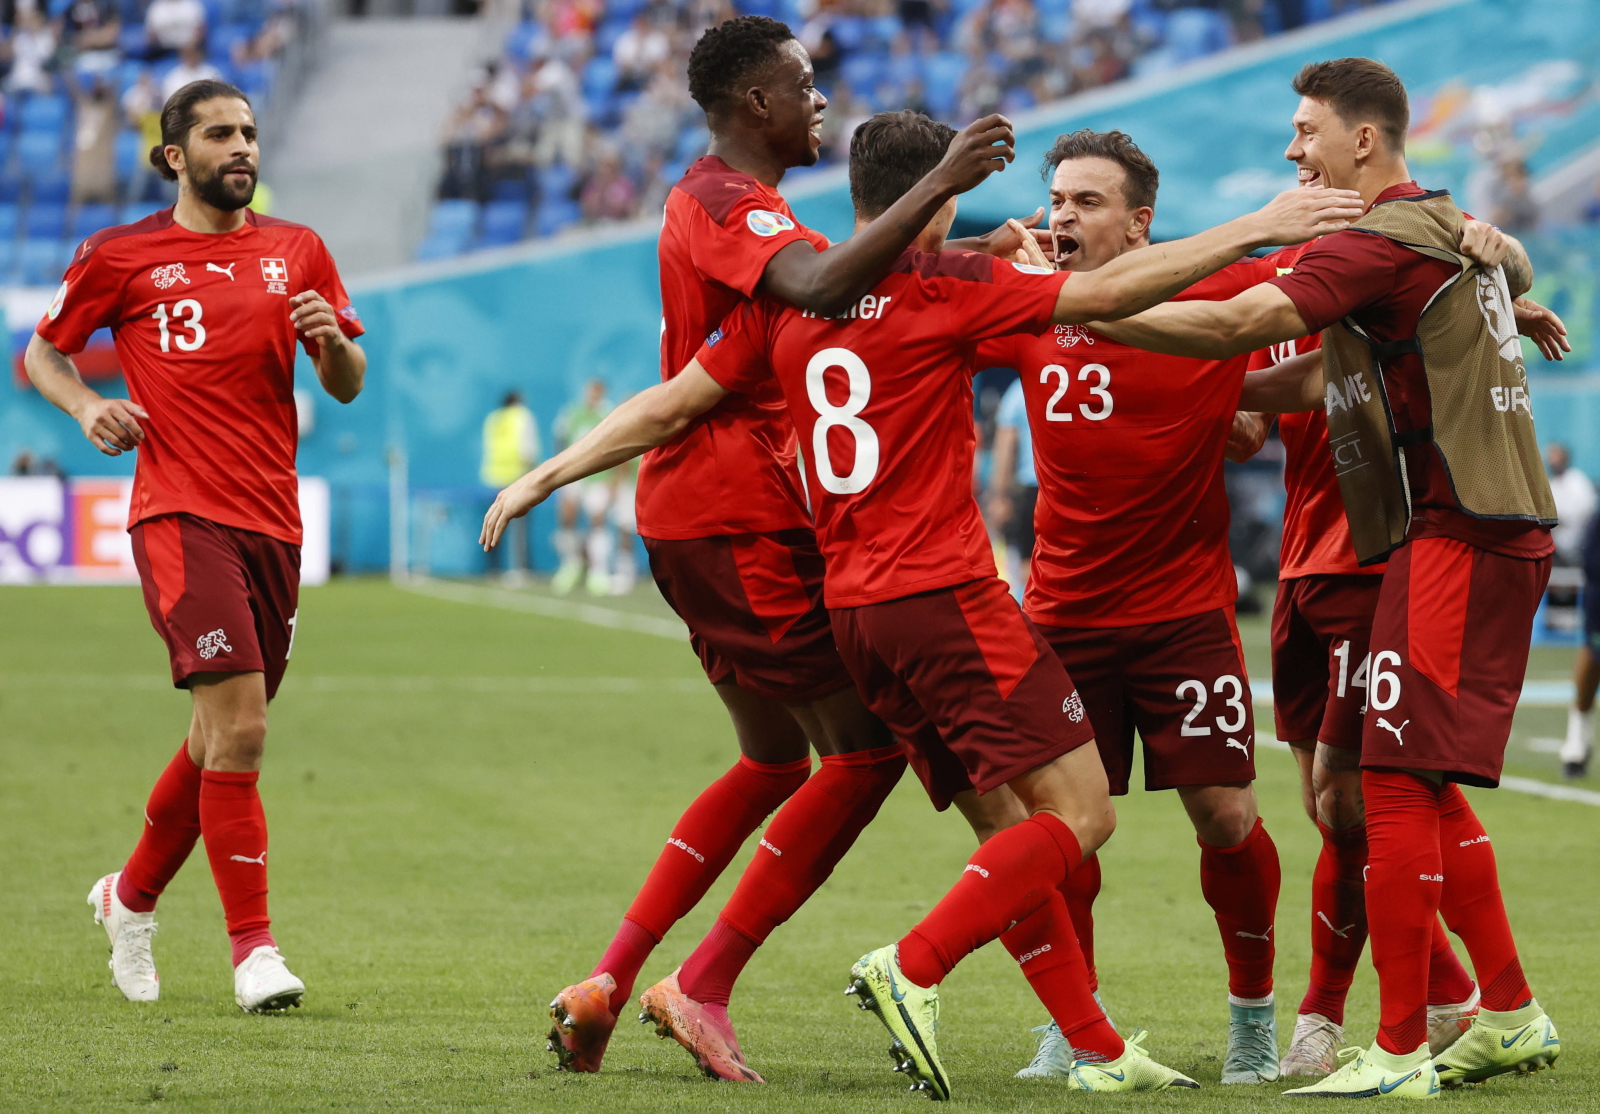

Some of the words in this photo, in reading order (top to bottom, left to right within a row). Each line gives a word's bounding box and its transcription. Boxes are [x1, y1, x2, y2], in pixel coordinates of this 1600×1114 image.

[152, 299, 206, 352] 13
[805, 347, 879, 494] 8
[1039, 363, 1114, 422] 23
[1324, 371, 1372, 416] AME
[1490, 386, 1534, 420] EUR
[1175, 674, 1247, 737] 23
